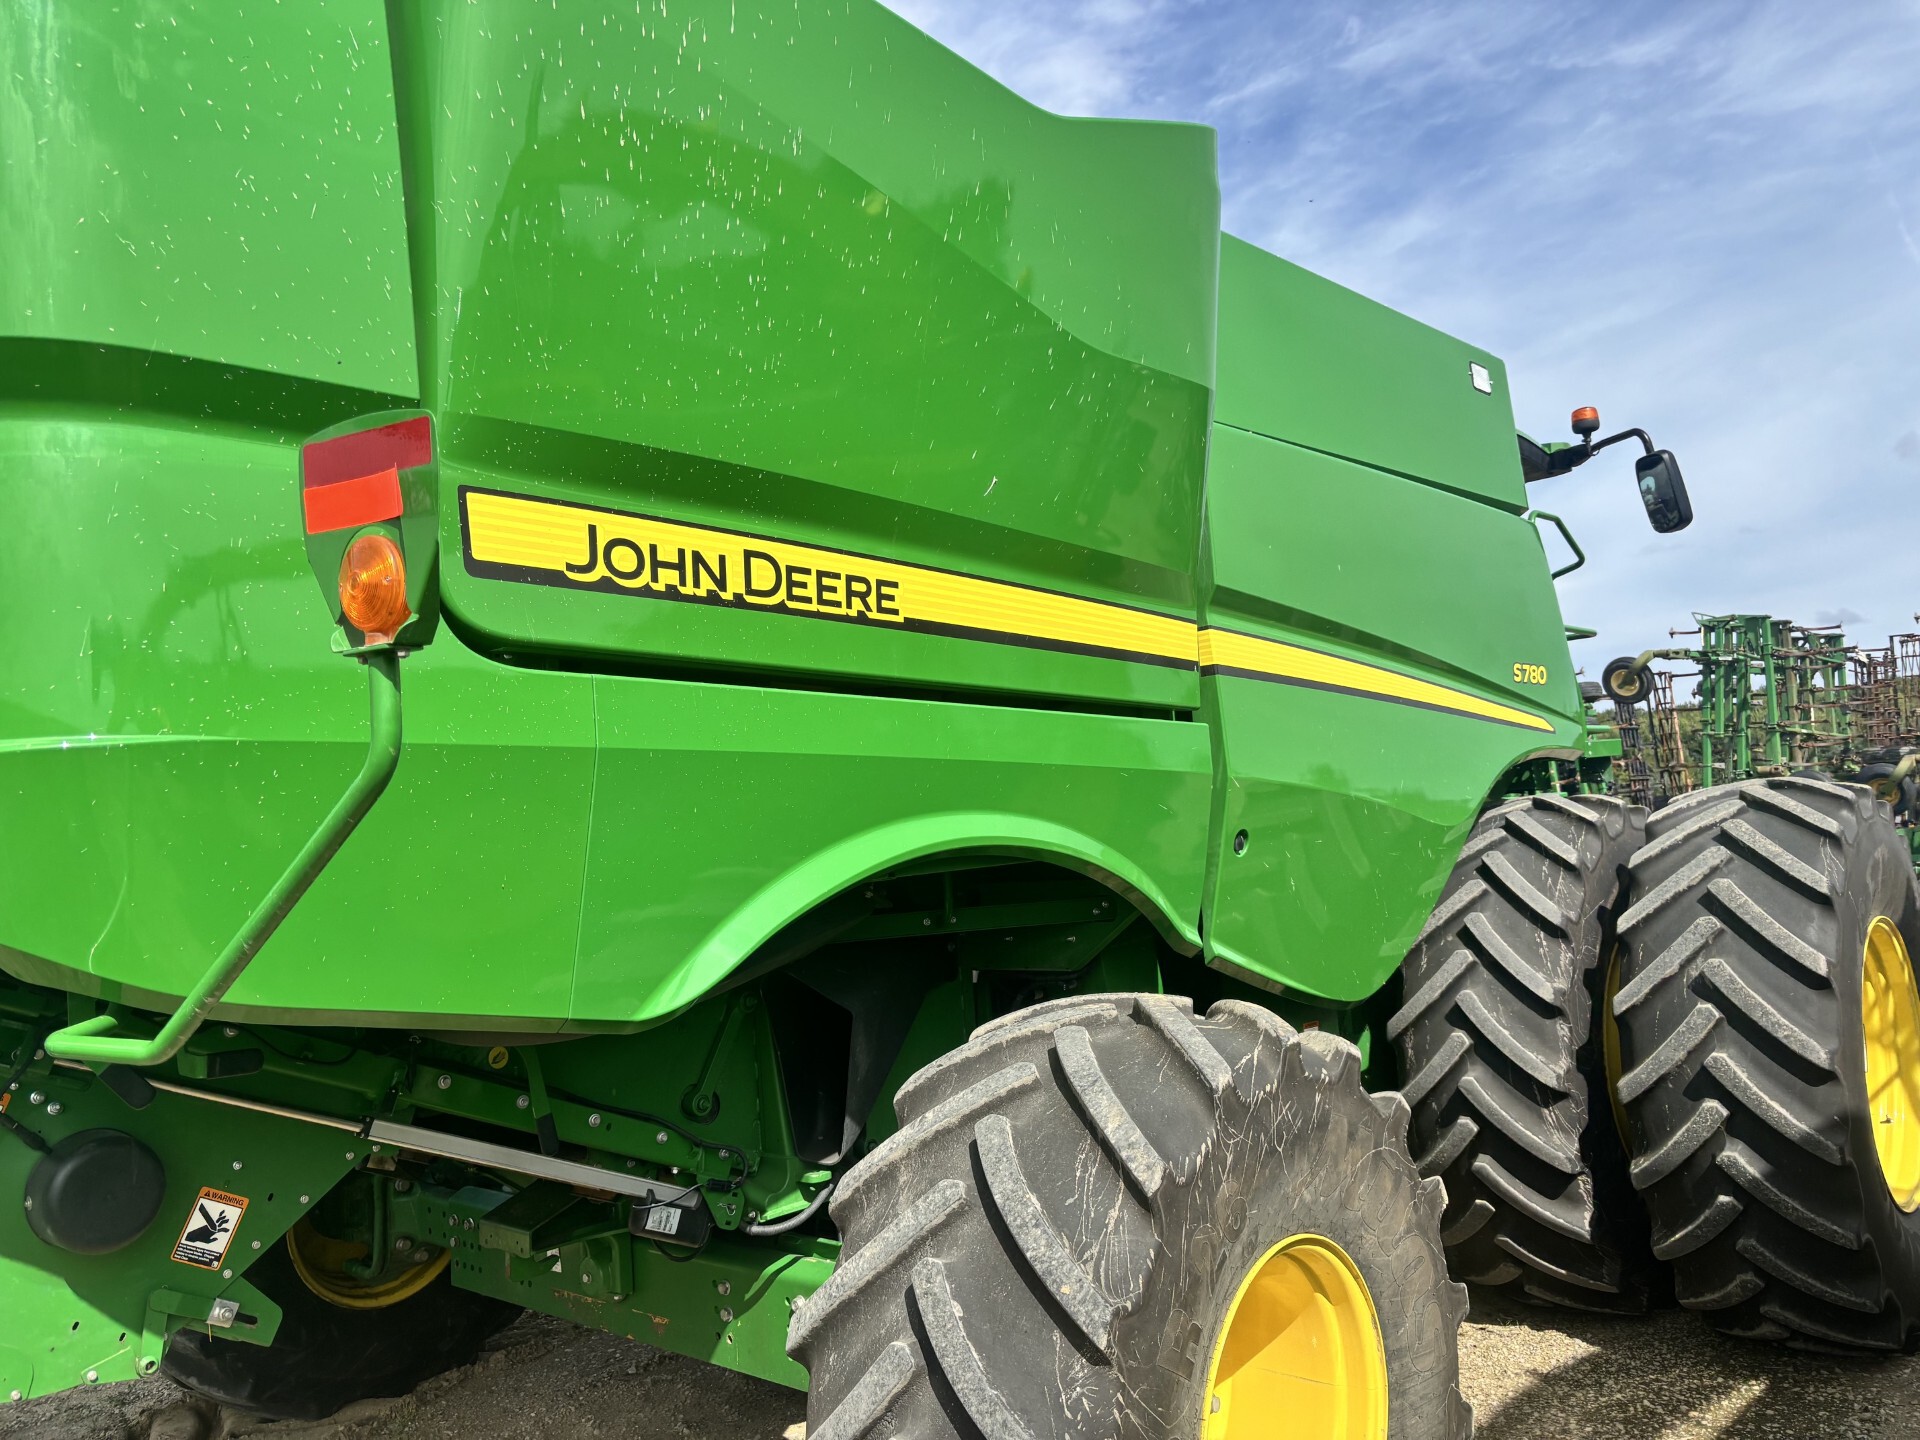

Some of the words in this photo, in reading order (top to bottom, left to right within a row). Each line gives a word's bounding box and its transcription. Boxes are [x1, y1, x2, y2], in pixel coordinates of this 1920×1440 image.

[565, 523, 729, 595] JOHN
[743, 548, 901, 616] DEERE
[1513, 662, 1547, 685] S780
[212, 1192, 244, 1206] WARNING
